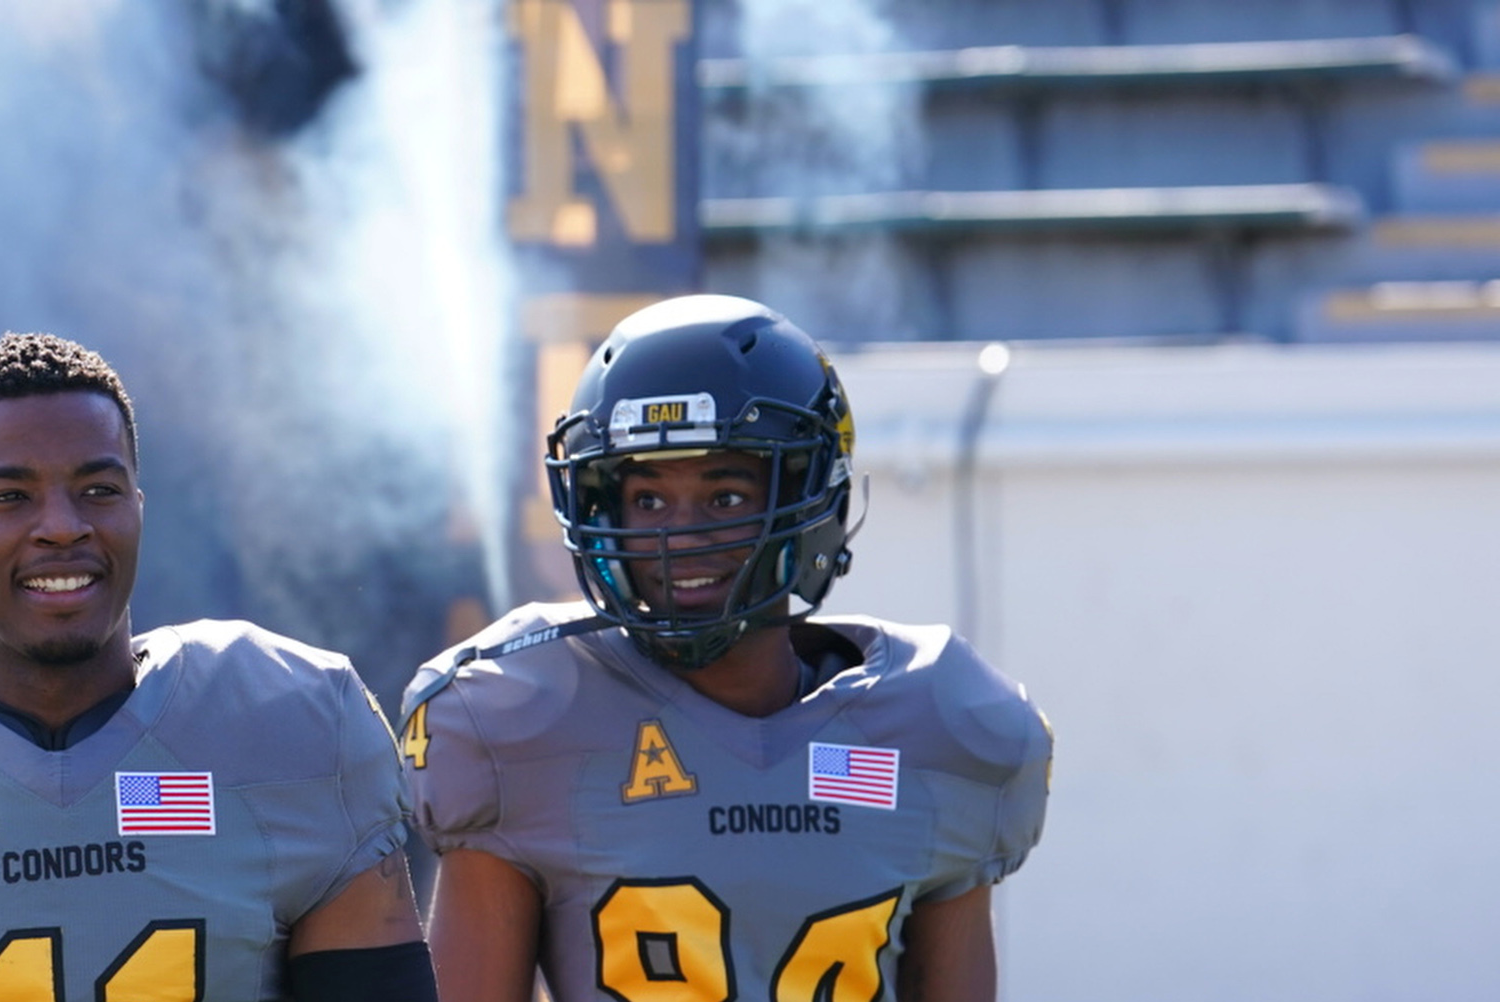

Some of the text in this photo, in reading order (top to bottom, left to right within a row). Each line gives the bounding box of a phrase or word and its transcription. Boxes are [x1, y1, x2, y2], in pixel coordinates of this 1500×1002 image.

[507, 0, 690, 244] N
[647, 403, 683, 423] GAU
[502, 627, 560, 654] schutt
[404, 701, 432, 770] 4
[621, 719, 698, 804] A
[708, 804, 841, 834] CONDORS
[2, 841, 146, 884] CONDORS
